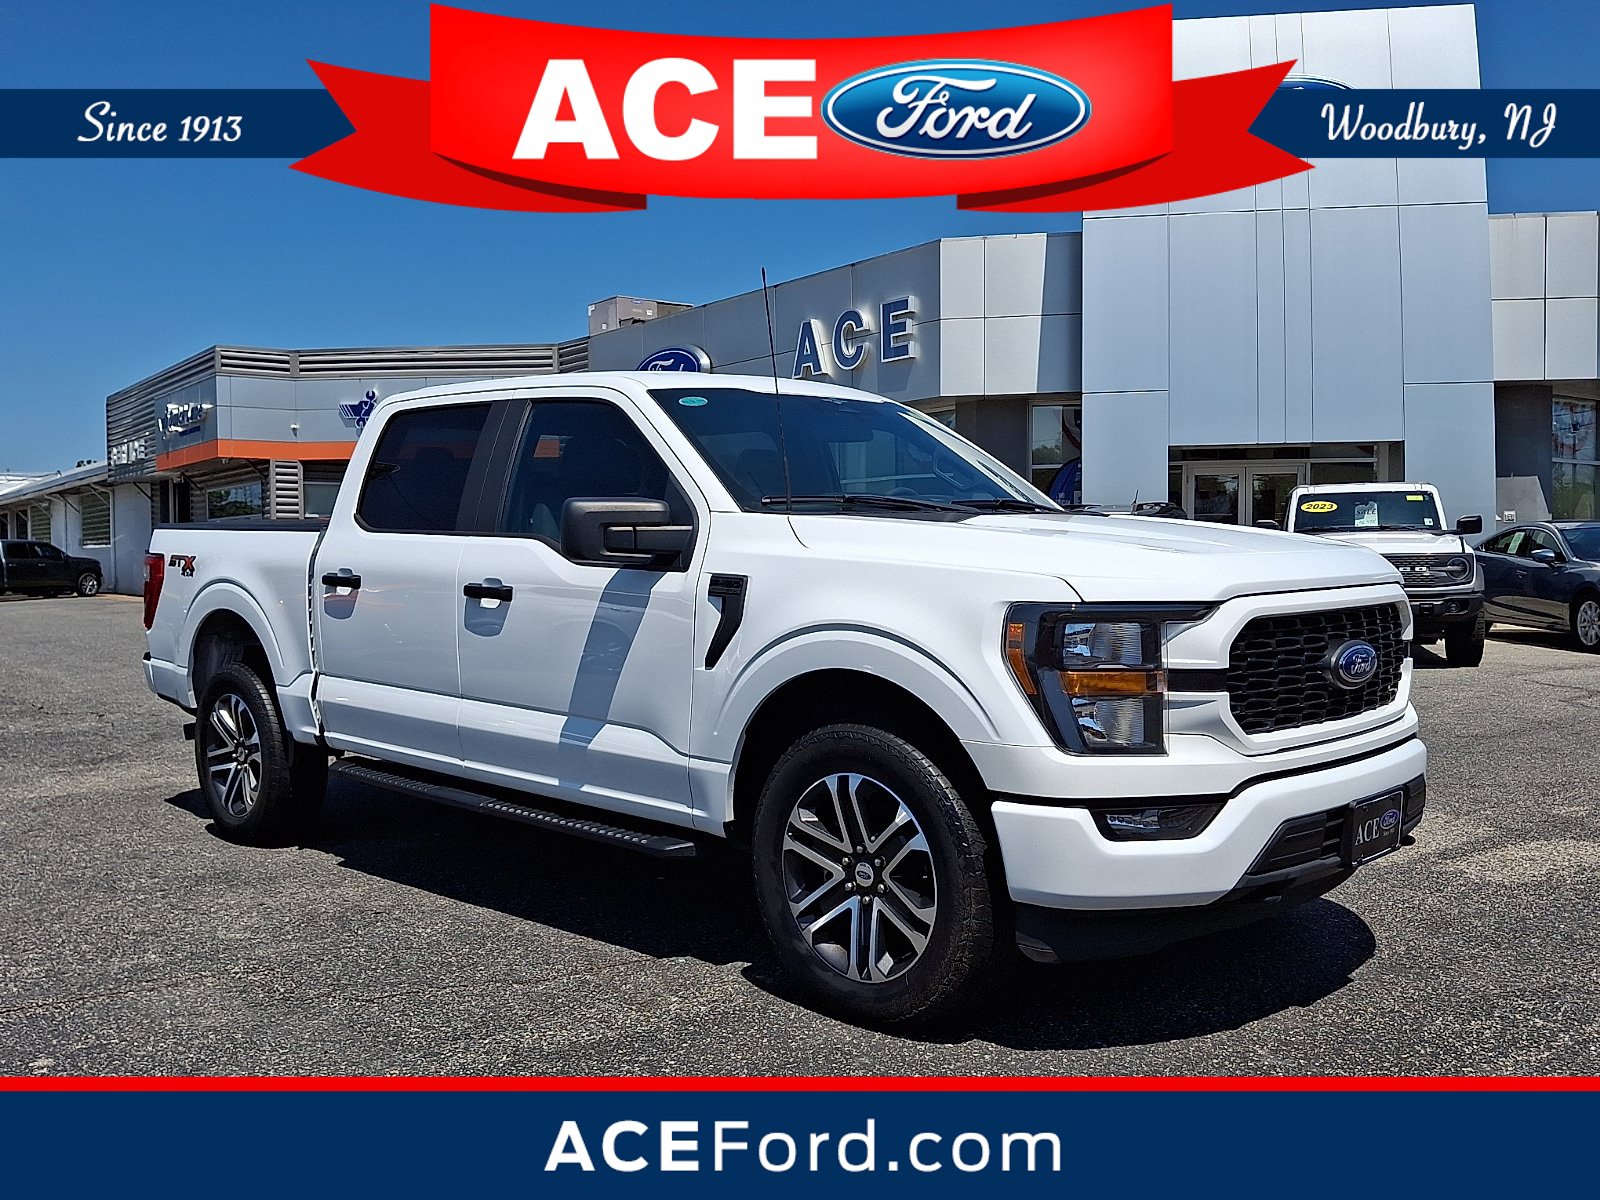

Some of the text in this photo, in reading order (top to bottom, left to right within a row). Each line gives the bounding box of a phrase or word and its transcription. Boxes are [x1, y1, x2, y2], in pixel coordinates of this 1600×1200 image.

[792, 295, 916, 379] ACE
[1351, 653, 1372, 675] Ford
[1354, 817, 1380, 846] ACE
